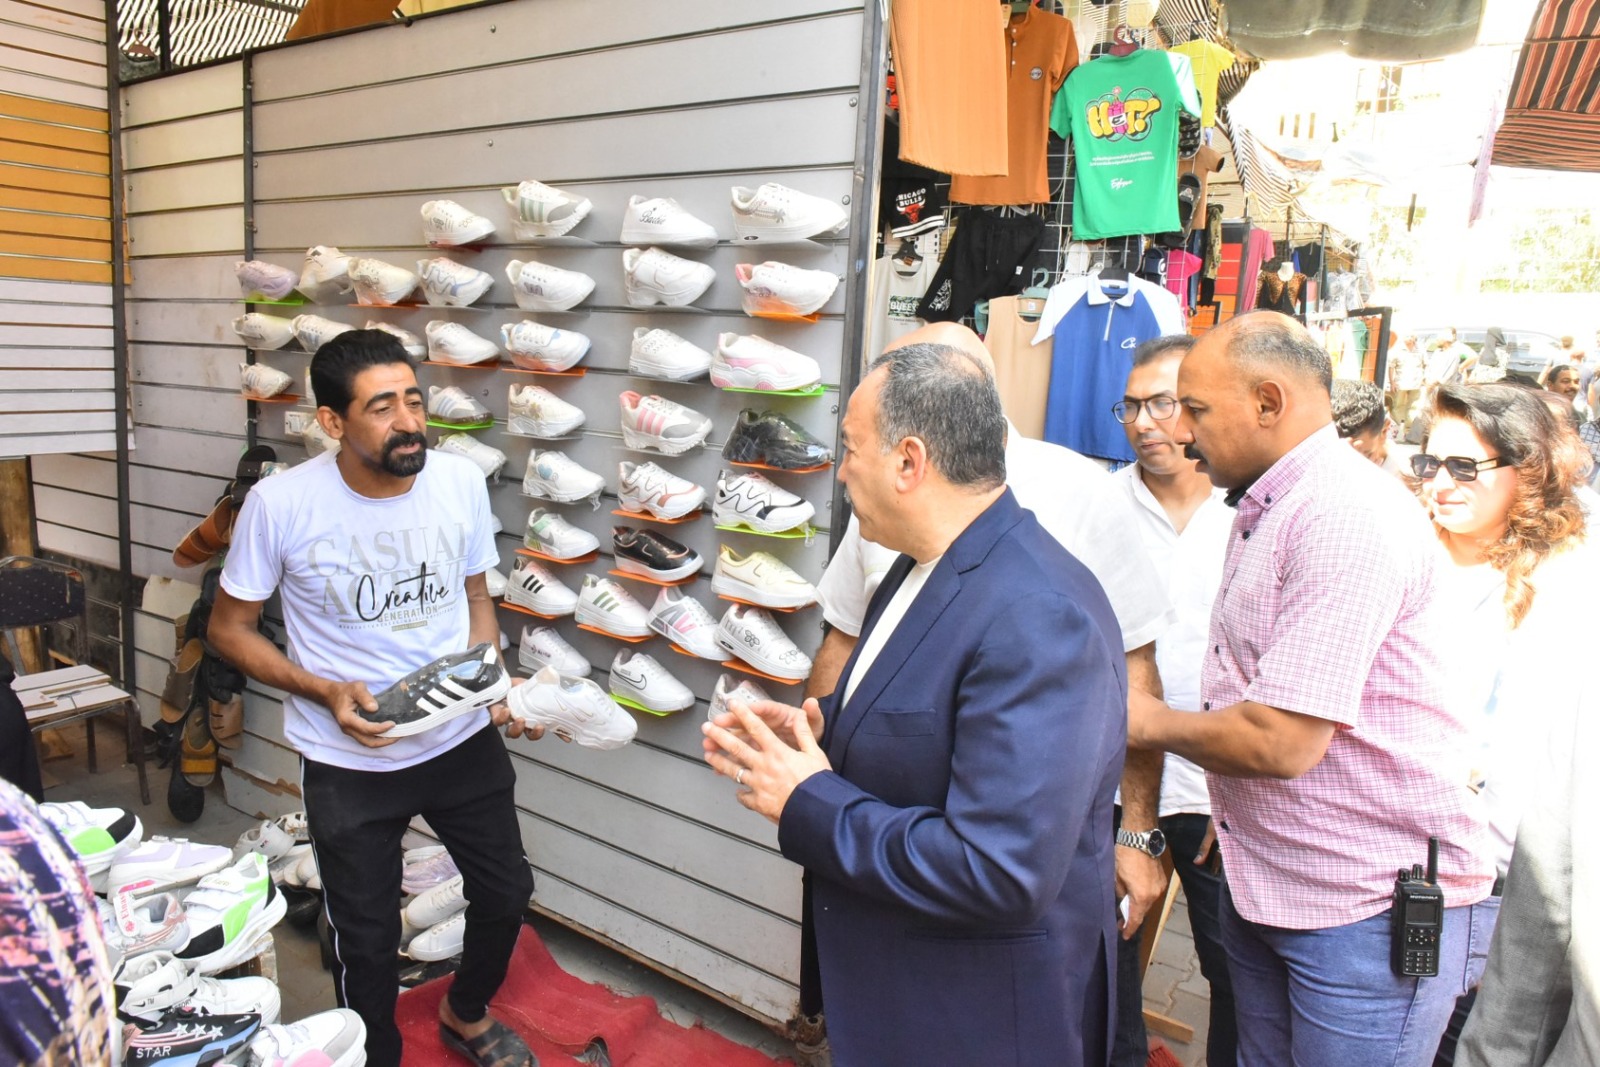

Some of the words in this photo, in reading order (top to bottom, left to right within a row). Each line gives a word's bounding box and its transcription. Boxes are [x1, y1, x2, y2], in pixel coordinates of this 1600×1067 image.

[899, 195, 923, 207] BULLS
[356, 561, 450, 622] Creative
[377, 604, 438, 623] GENERATON
[147, 997, 155, 1006] TM
[135, 1046, 172, 1059] STAR
